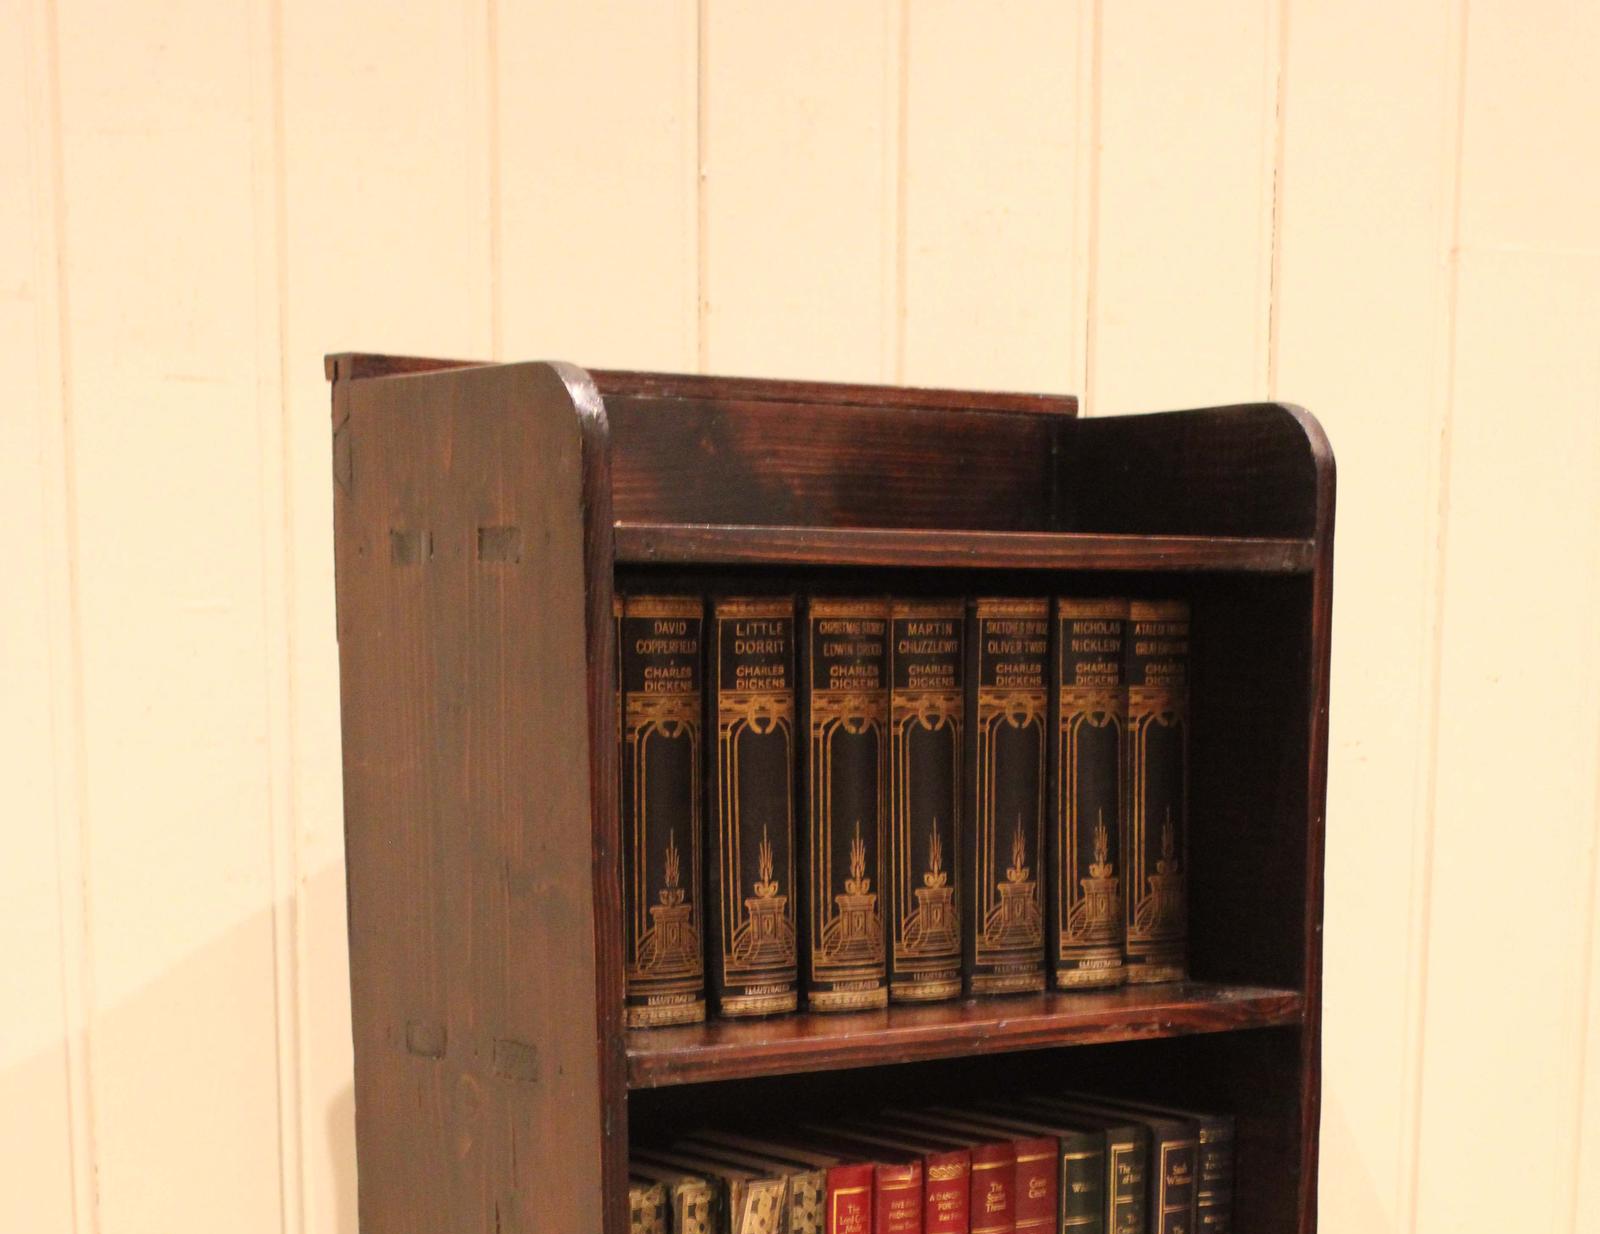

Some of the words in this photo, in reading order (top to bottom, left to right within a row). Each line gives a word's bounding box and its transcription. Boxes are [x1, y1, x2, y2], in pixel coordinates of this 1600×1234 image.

[654, 620, 687, 636] DAVID
[735, 622, 784, 637] LITTLE
[907, 622, 953, 636] MARTIN
[1072, 622, 1121, 635] NICHOLAS
[635, 639, 697, 655] COPPERFIELD
[735, 640, 785, 655] DORRIT
[898, 639, 959, 655] CHUZZLEWIT
[987, 640, 1022, 655] OLIVER
[1071, 638, 1122, 653] NICKLEBY
[643, 665, 692, 679] CHARLES
[736, 664, 785, 677] CHARLES
[829, 664, 880, 676] CHARLES
[908, 663, 954, 675] CHARLES
[995, 663, 1042, 674] CHARLES
[1075, 662, 1119, 673] CHARLES
[643, 679, 692, 692] DICKENS
[736, 678, 786, 690] DICKENS
[829, 677, 880, 689] DICKENS
[908, 676, 955, 689] DICKENS
[995, 675, 1042, 688] DICKENS
[1075, 674, 1120, 688] DICKENS
